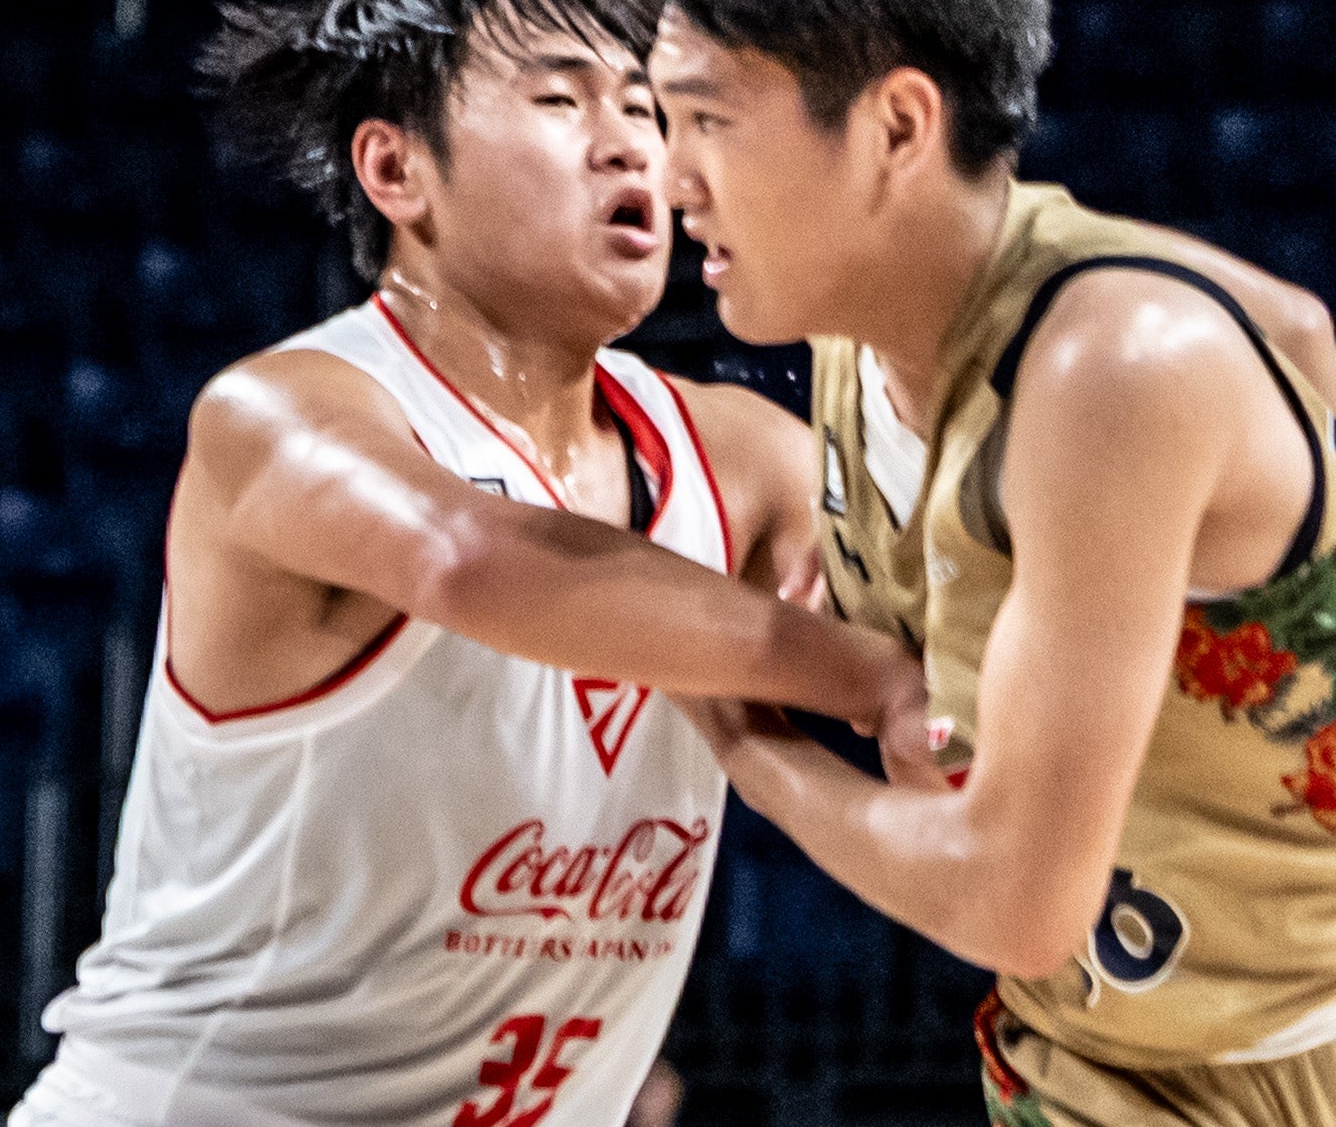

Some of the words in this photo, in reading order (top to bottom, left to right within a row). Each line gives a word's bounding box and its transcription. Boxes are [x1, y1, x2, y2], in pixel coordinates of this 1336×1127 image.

[445, 930, 573, 962] BOTTLRS
[585, 938, 649, 962] APAN
[451, 1014, 603, 1127] 35
